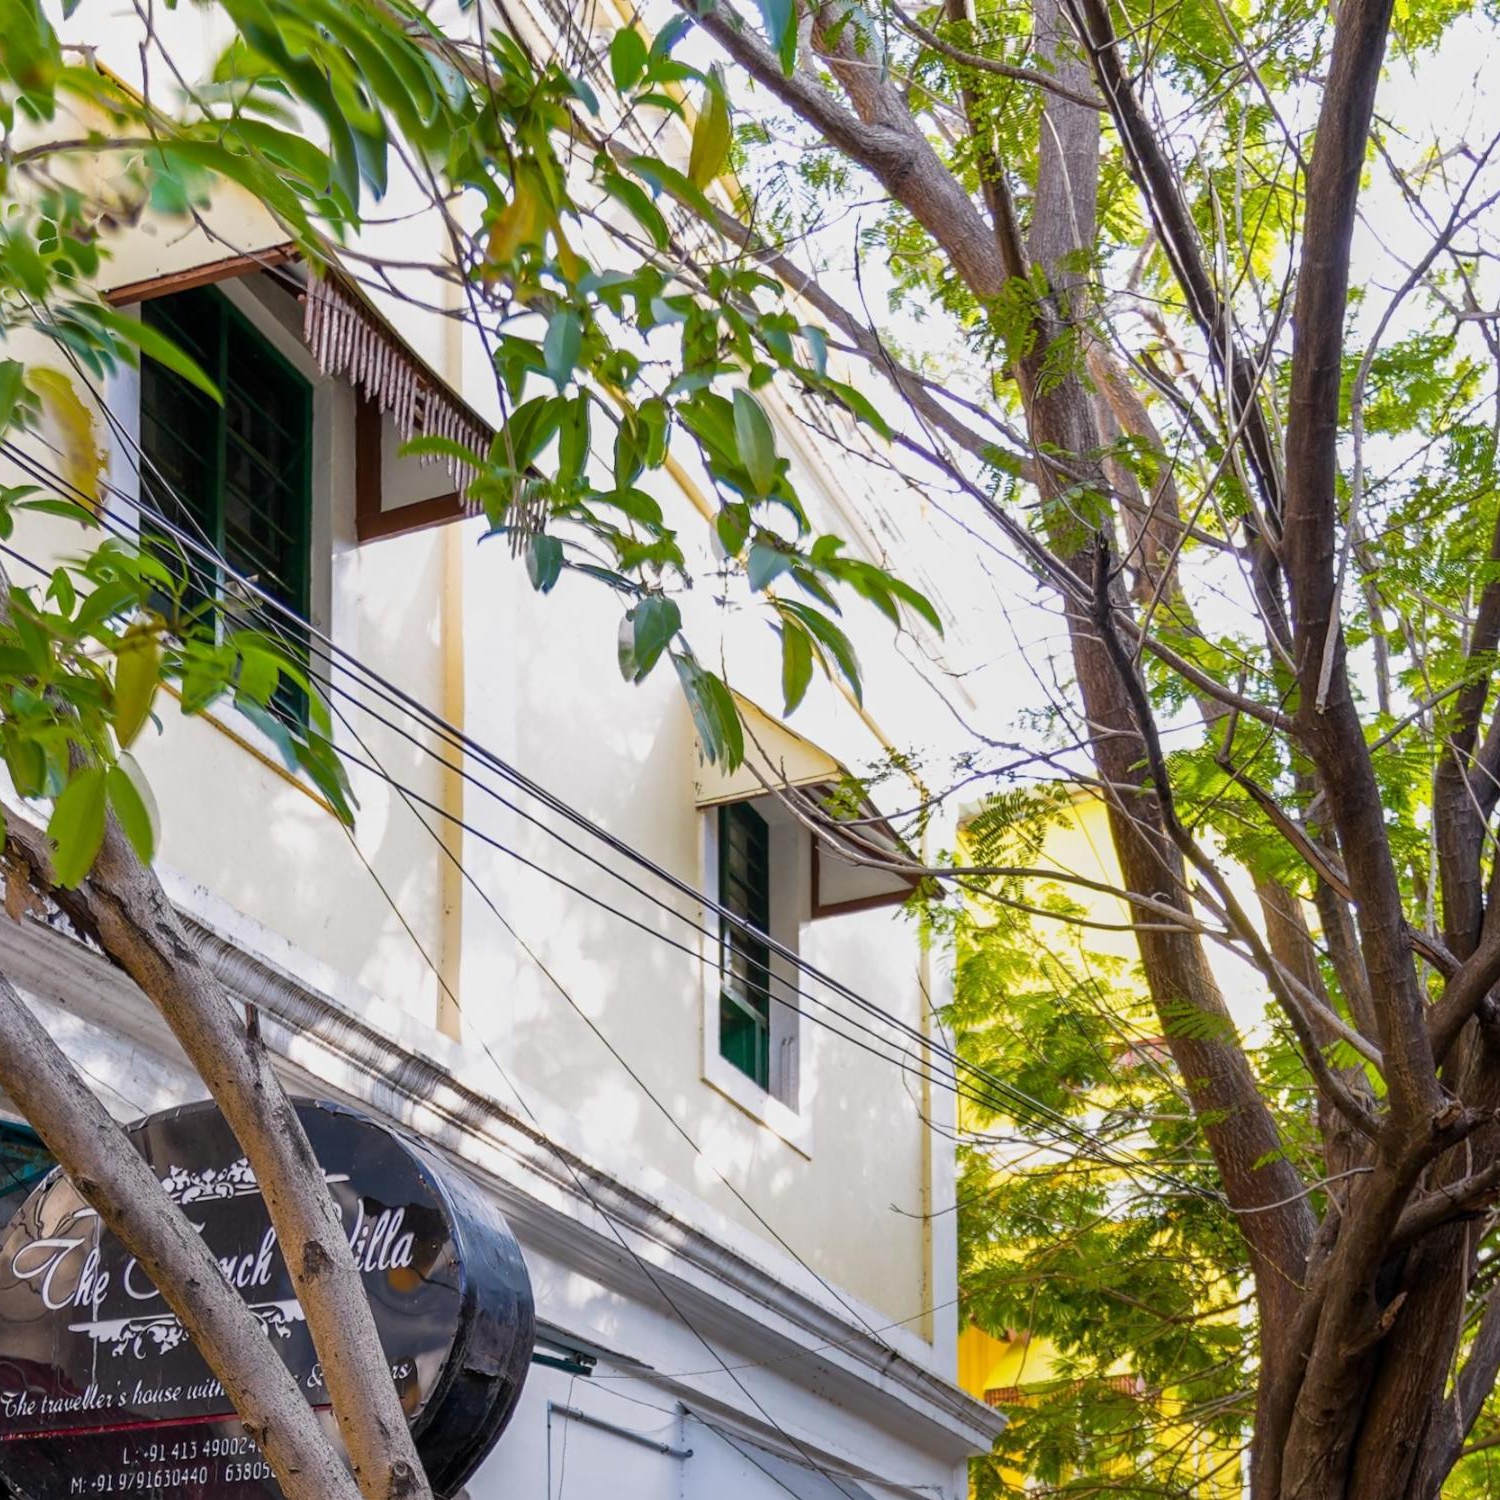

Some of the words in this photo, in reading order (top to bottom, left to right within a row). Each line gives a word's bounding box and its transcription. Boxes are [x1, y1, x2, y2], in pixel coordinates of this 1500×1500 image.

[12, 1238, 109, 1310] The
[0, 1390, 34, 1418] The
[132, 1379, 181, 1405] house
[186, 1377, 226, 1400] with
[171, 1441, 198, 1461] 413
[202, 1436, 263, 1458] 490024
[119, 1466, 208, 1490] 9791630440
